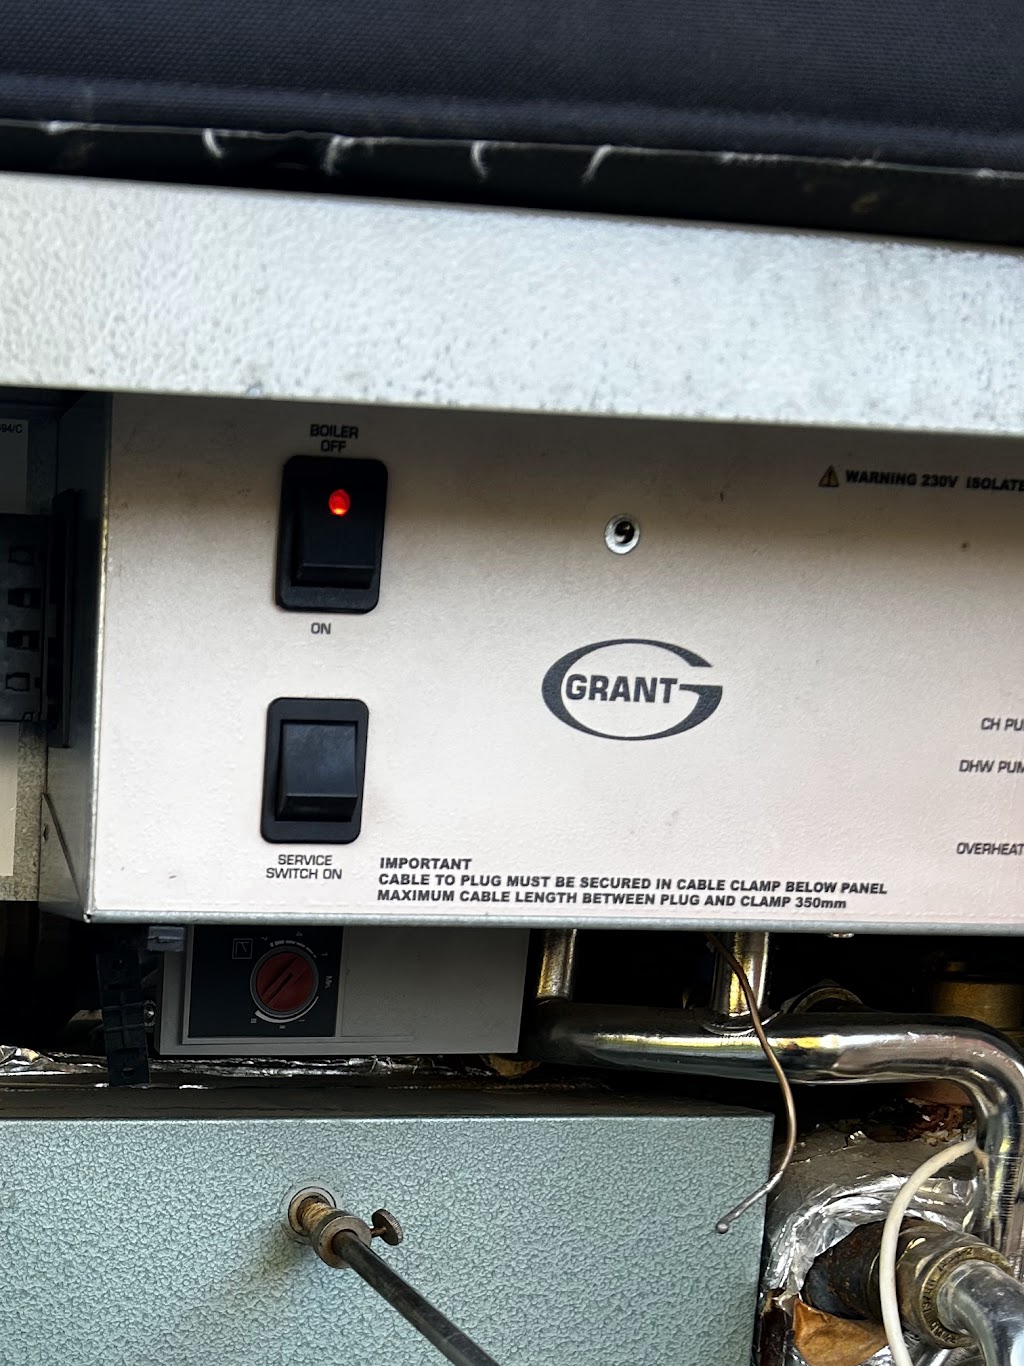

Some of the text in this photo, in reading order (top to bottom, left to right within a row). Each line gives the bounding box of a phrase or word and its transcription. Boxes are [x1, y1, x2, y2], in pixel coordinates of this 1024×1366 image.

[310, 424, 359, 439] BOILER
[320, 440, 347, 453] OFF
[845, 470, 917, 486] WARNING
[921, 474, 959, 488] 230V
[311, 622, 331, 635] ON
[565, 673, 678, 704] GRANT
[981, 717, 1001, 731] CH
[959, 759, 995, 773] DHW
[278, 854, 333, 866] SERVICE
[379, 857, 472, 870] IMPORTANT
[265, 867, 343, 880] SWITCH ON
[378, 873, 888, 895] CABLE TO PLUG MUST BE SECURED IN CABLE CLAMP BELOW PANEL
[377, 889, 847, 909] MAXIMUM CABLE LENGTH BETWEEN PLUG AND CLAMP 350mm
